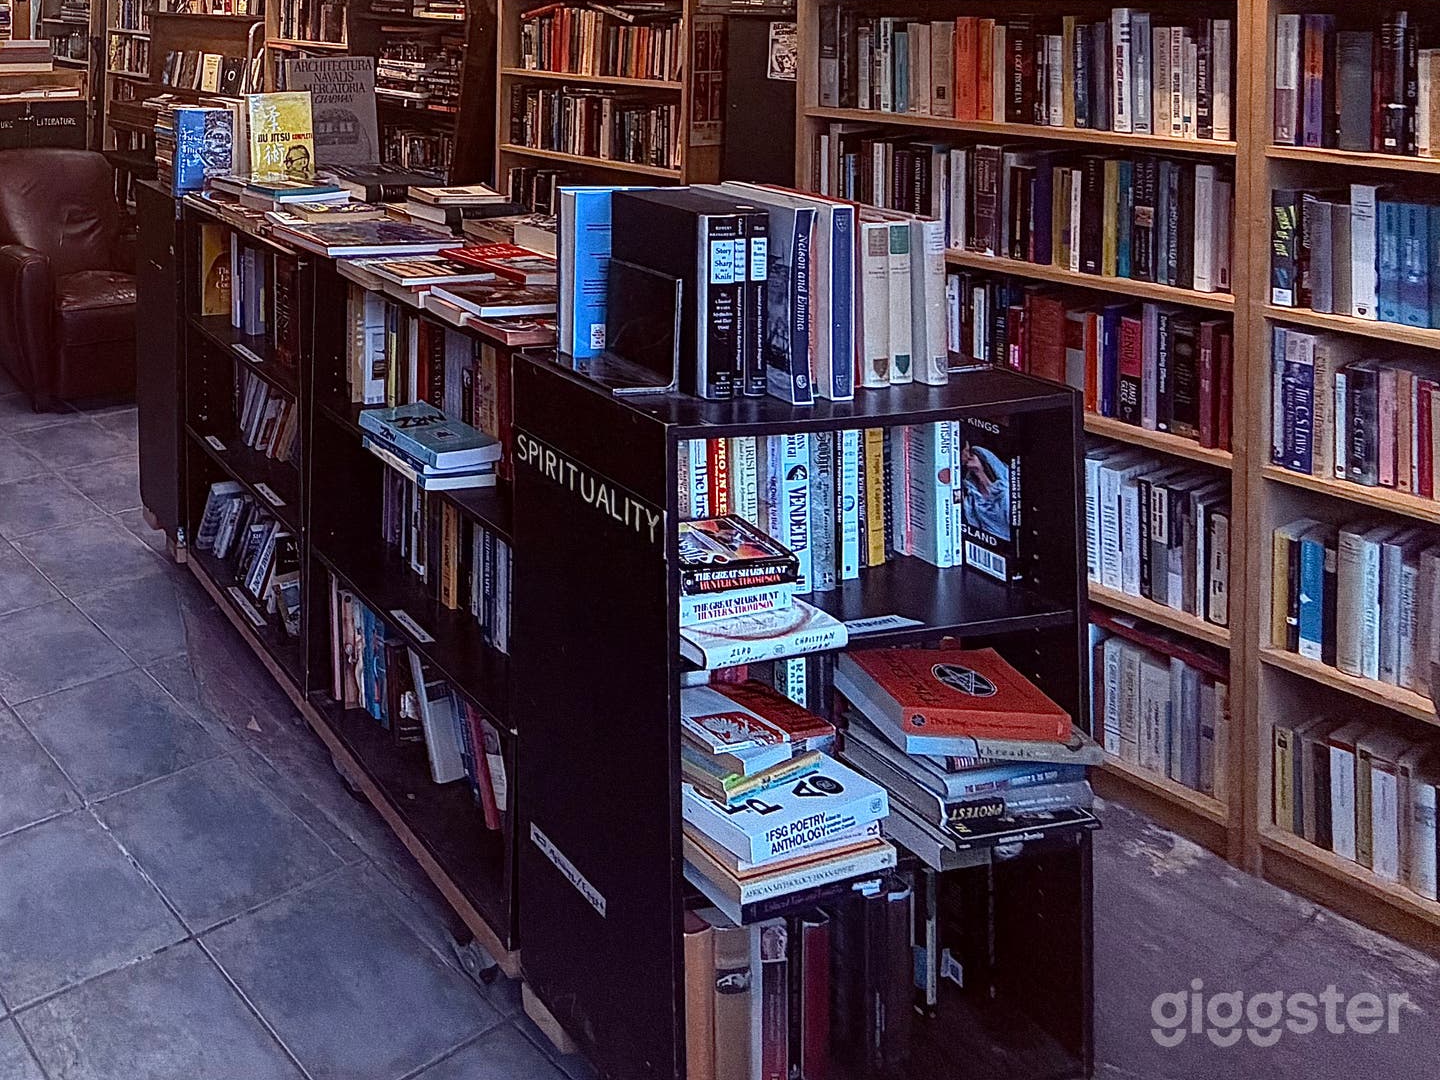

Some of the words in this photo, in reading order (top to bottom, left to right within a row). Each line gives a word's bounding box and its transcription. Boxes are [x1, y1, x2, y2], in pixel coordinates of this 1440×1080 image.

[294, 59, 373, 72] ARCHITECTURA
[314, 71, 355, 83] NAVALIS
[304, 81, 366, 95] MERCATORIA
[36, 117, 77, 126] LITERATURE
[271, 132, 291, 142] JITSU
[715, 248, 732, 257] Story
[798, 233, 808, 269] Nelson
[714, 260, 733, 268] Sharp
[715, 272, 732, 280] Knife
[798, 272, 808, 293] and
[796, 294, 808, 332] Emma
[1159, 351, 1168, 367] Doing
[967, 416, 1000, 434] KINGS
[718, 437, 727, 471] WHO
[745, 445, 756, 478] IRISH
[694, 460, 708, 491] The
[718, 473, 727, 489] IN
[517, 433, 661, 544] SPIRITUALITY
[789, 485, 808, 553] VENDETTA
[694, 570, 711, 582] THE
[711, 568, 738, 580] GREAT
[738, 567, 764, 578] SHARK
[764, 565, 788, 576] HUNT
[699, 578, 730, 590] HUNTER
[738, 573, 781, 587] THOMPSON
[692, 604, 710, 614] THE
[709, 599, 733, 611] GREAT
[733, 595, 759, 608] SHARK
[759, 591, 779, 603] HUNT
[697, 607, 728, 621] HUNTER
[734, 600, 774, 615] THOMPSON
[794, 632, 836, 647] CHRISTIAN
[980, 746, 1033, 758] threads
[952, 802, 1003, 819] PROTEST
[770, 825, 788, 842] FSG
[790, 811, 826, 834] POETRY
[771, 824, 826, 856] ANTHOLOGY
[744, 884, 773, 899] AFRICAN
[772, 875, 813, 892] MYTHOLOGY
[813, 872, 825, 882] JAN
